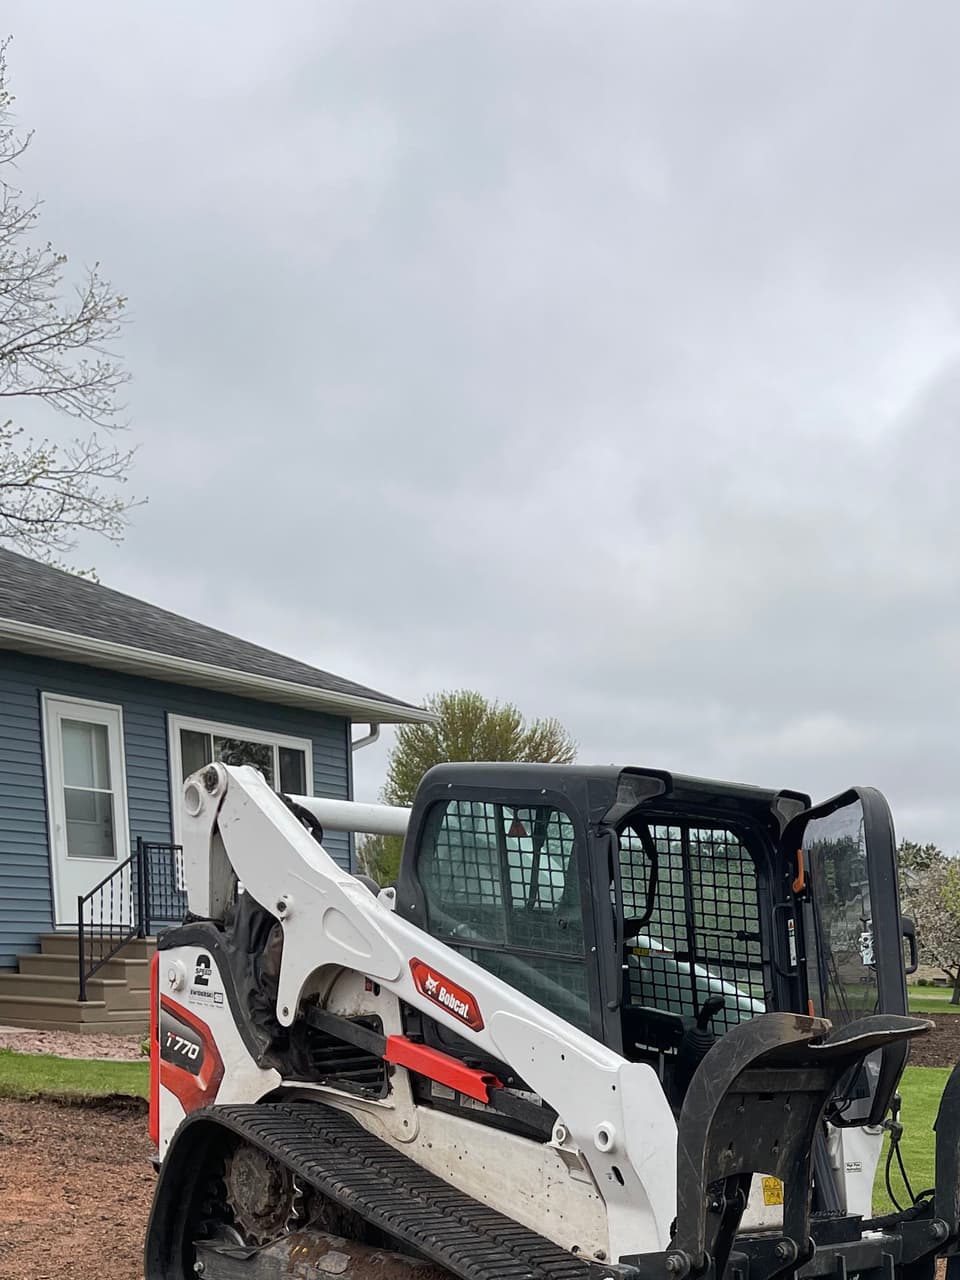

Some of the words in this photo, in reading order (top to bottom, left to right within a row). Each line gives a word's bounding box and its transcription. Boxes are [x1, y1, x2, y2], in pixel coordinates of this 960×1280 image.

[194, 954, 211, 986] 2
[195, 967, 212, 976] SPEED
[438, 986, 470, 1019] Bobcat
[166, 1031, 200, 1060] T770
